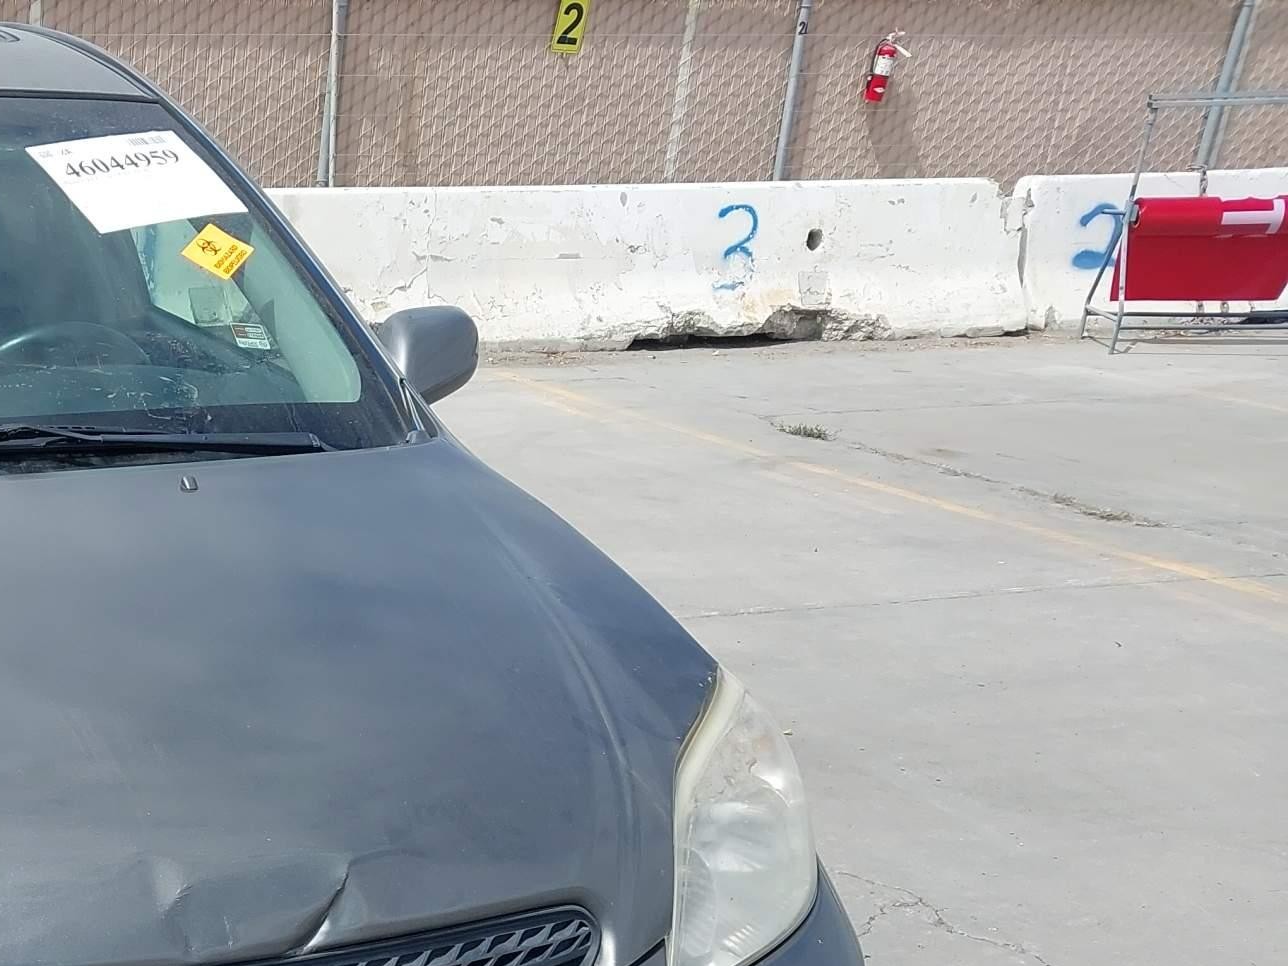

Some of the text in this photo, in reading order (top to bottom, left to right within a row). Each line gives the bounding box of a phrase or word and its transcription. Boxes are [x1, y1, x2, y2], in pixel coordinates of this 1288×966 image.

[556, 2, 584, 45] 2
[65, 149, 179, 177] 46044959
[1072, 203, 1125, 269] 2
